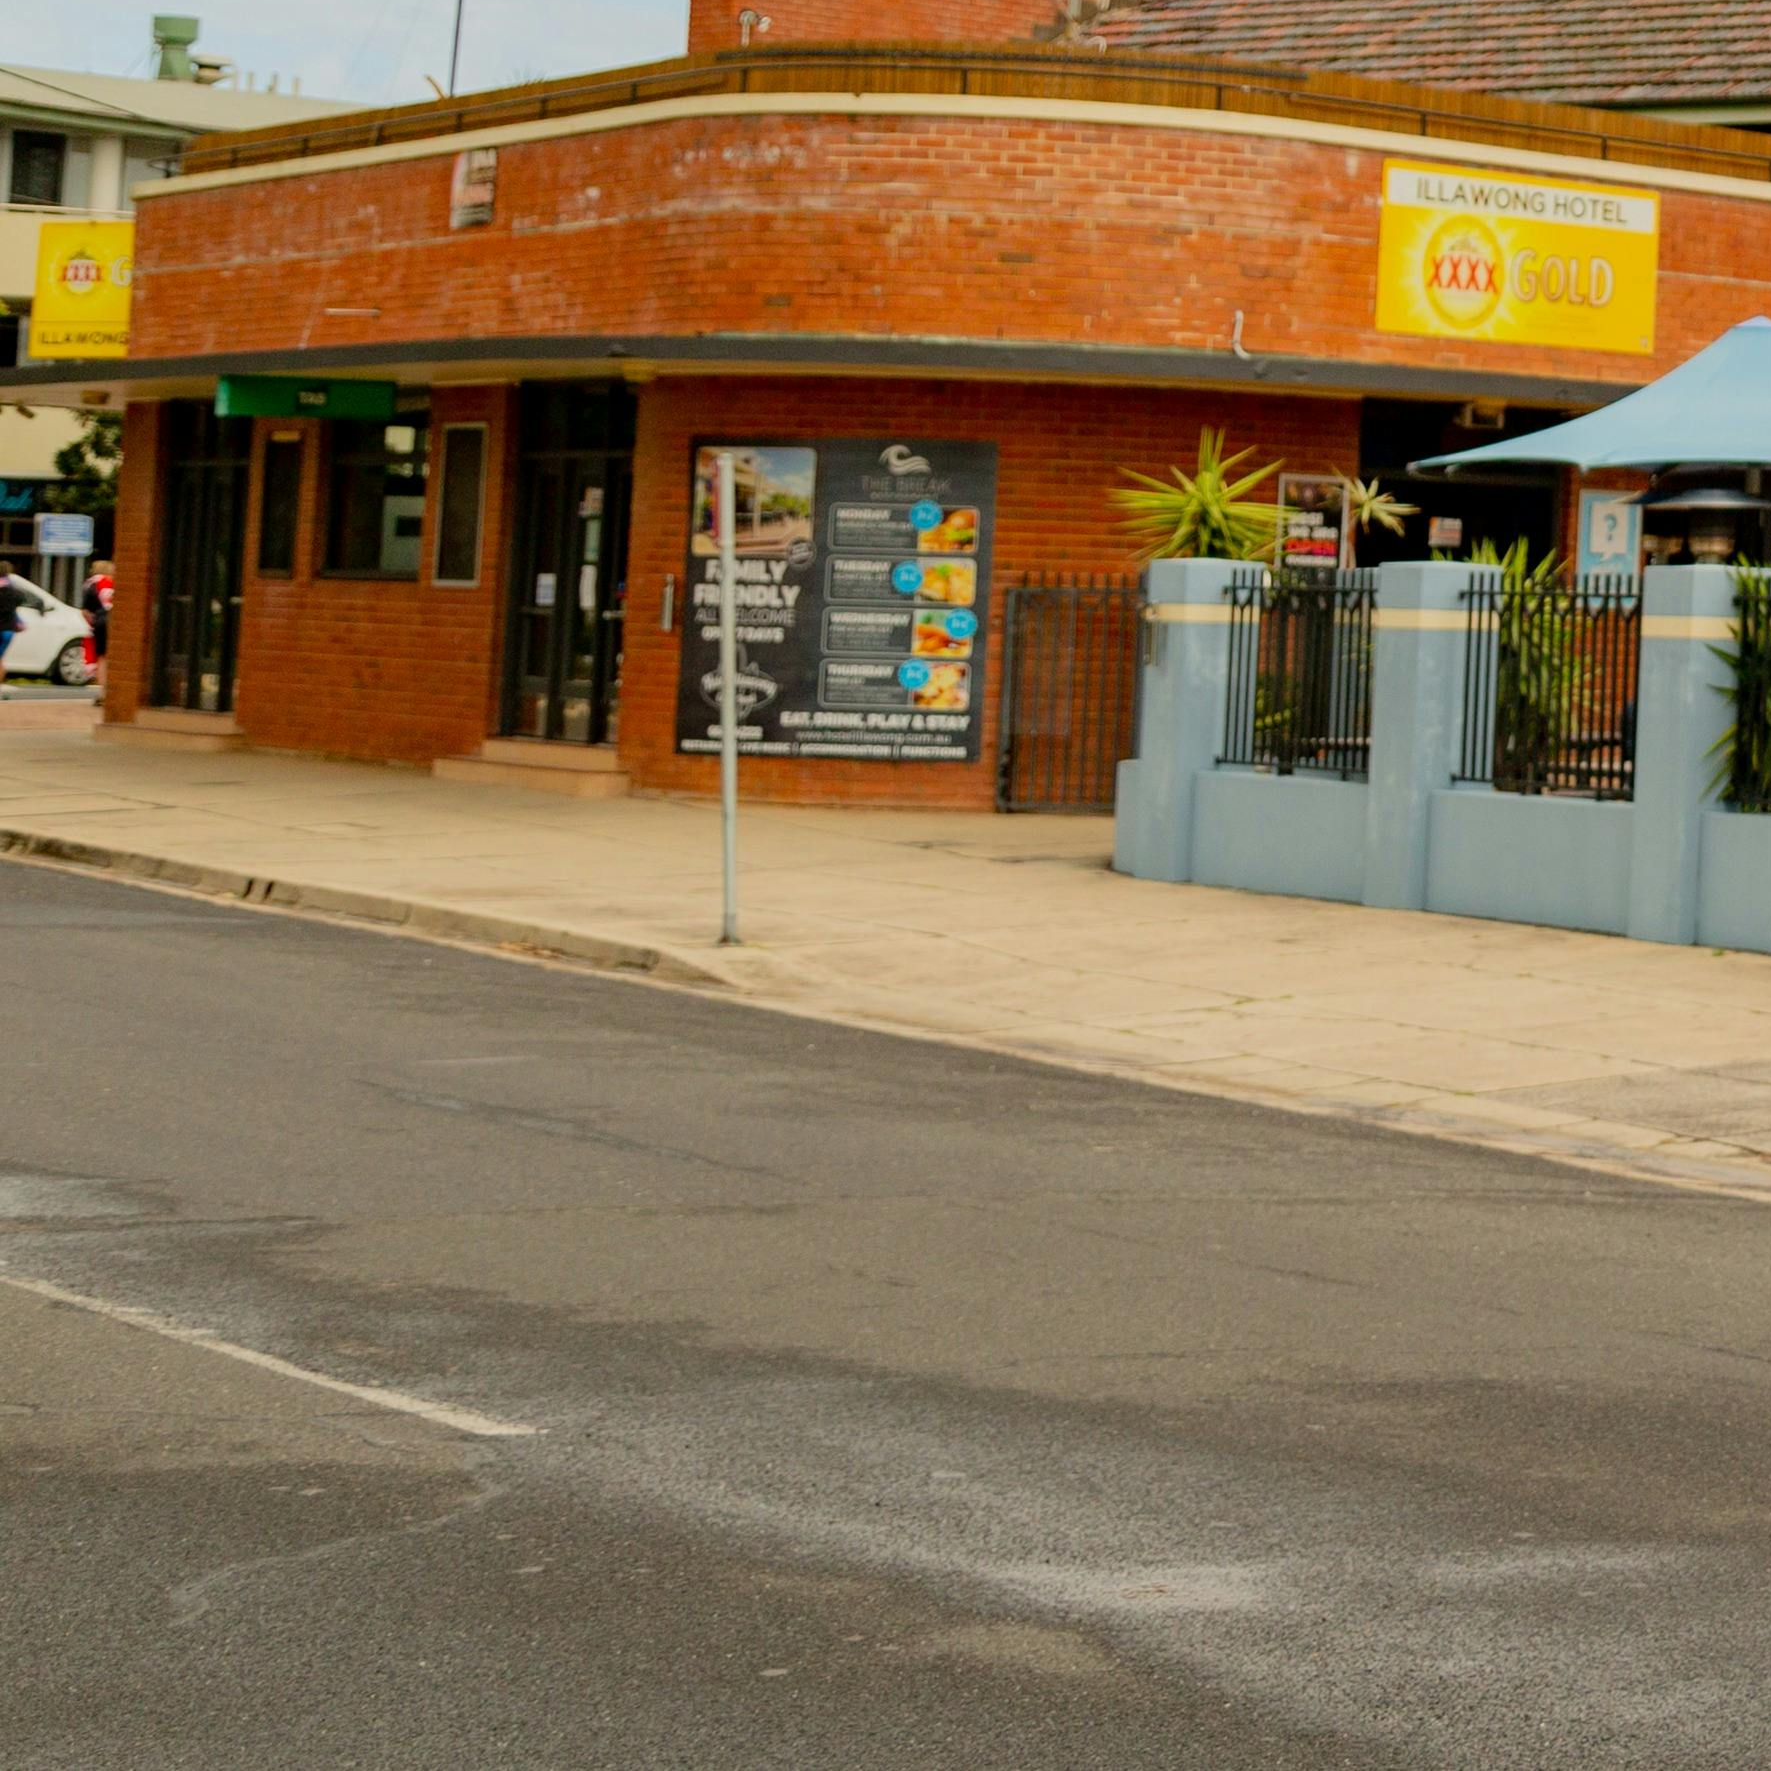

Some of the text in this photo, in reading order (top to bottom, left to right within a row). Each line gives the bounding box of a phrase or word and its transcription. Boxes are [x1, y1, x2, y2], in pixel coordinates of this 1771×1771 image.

[1416, 176, 1628, 225] ILLAWONG HOTEL
[1428, 246, 1616, 309] XXXX GOLD
[704, 557, 789, 584] FMILY
[693, 582, 801, 608] FRINDLY
[732, 608, 796, 628] ELCOME
